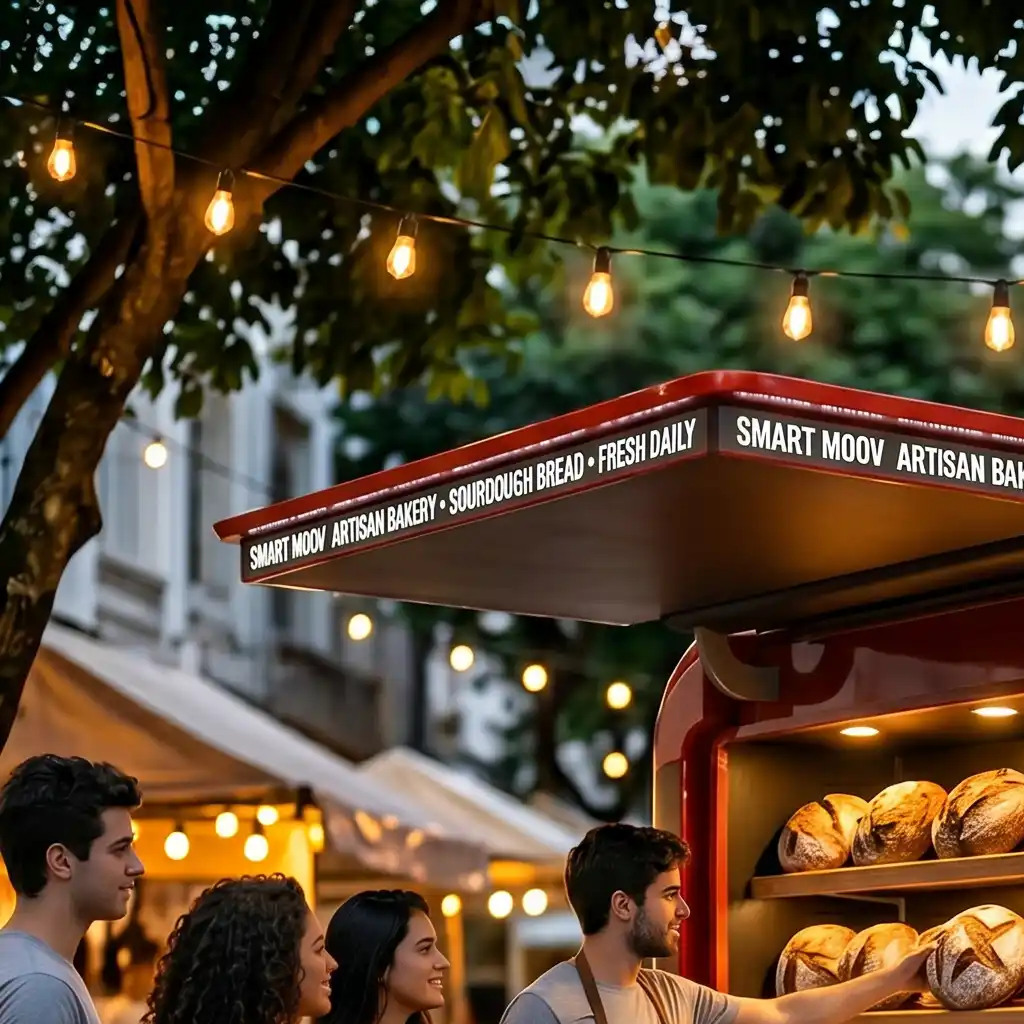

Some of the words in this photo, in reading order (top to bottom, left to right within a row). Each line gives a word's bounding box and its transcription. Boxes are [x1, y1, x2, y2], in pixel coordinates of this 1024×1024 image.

[250, 536, 289, 569] SMART
[292, 525, 326, 558] MOOV
[332, 509, 384, 548] ARTISAN
[388, 494, 437, 532] BAKERY
[537, 452, 584, 490] BREAD
[599, 434, 645, 473] FRESH
[650, 418, 696, 458] DAILY
[737, 416, 815, 456] SMART
[823, 430, 884, 466] MOOV
[897, 443, 984, 483] ARTISAN
